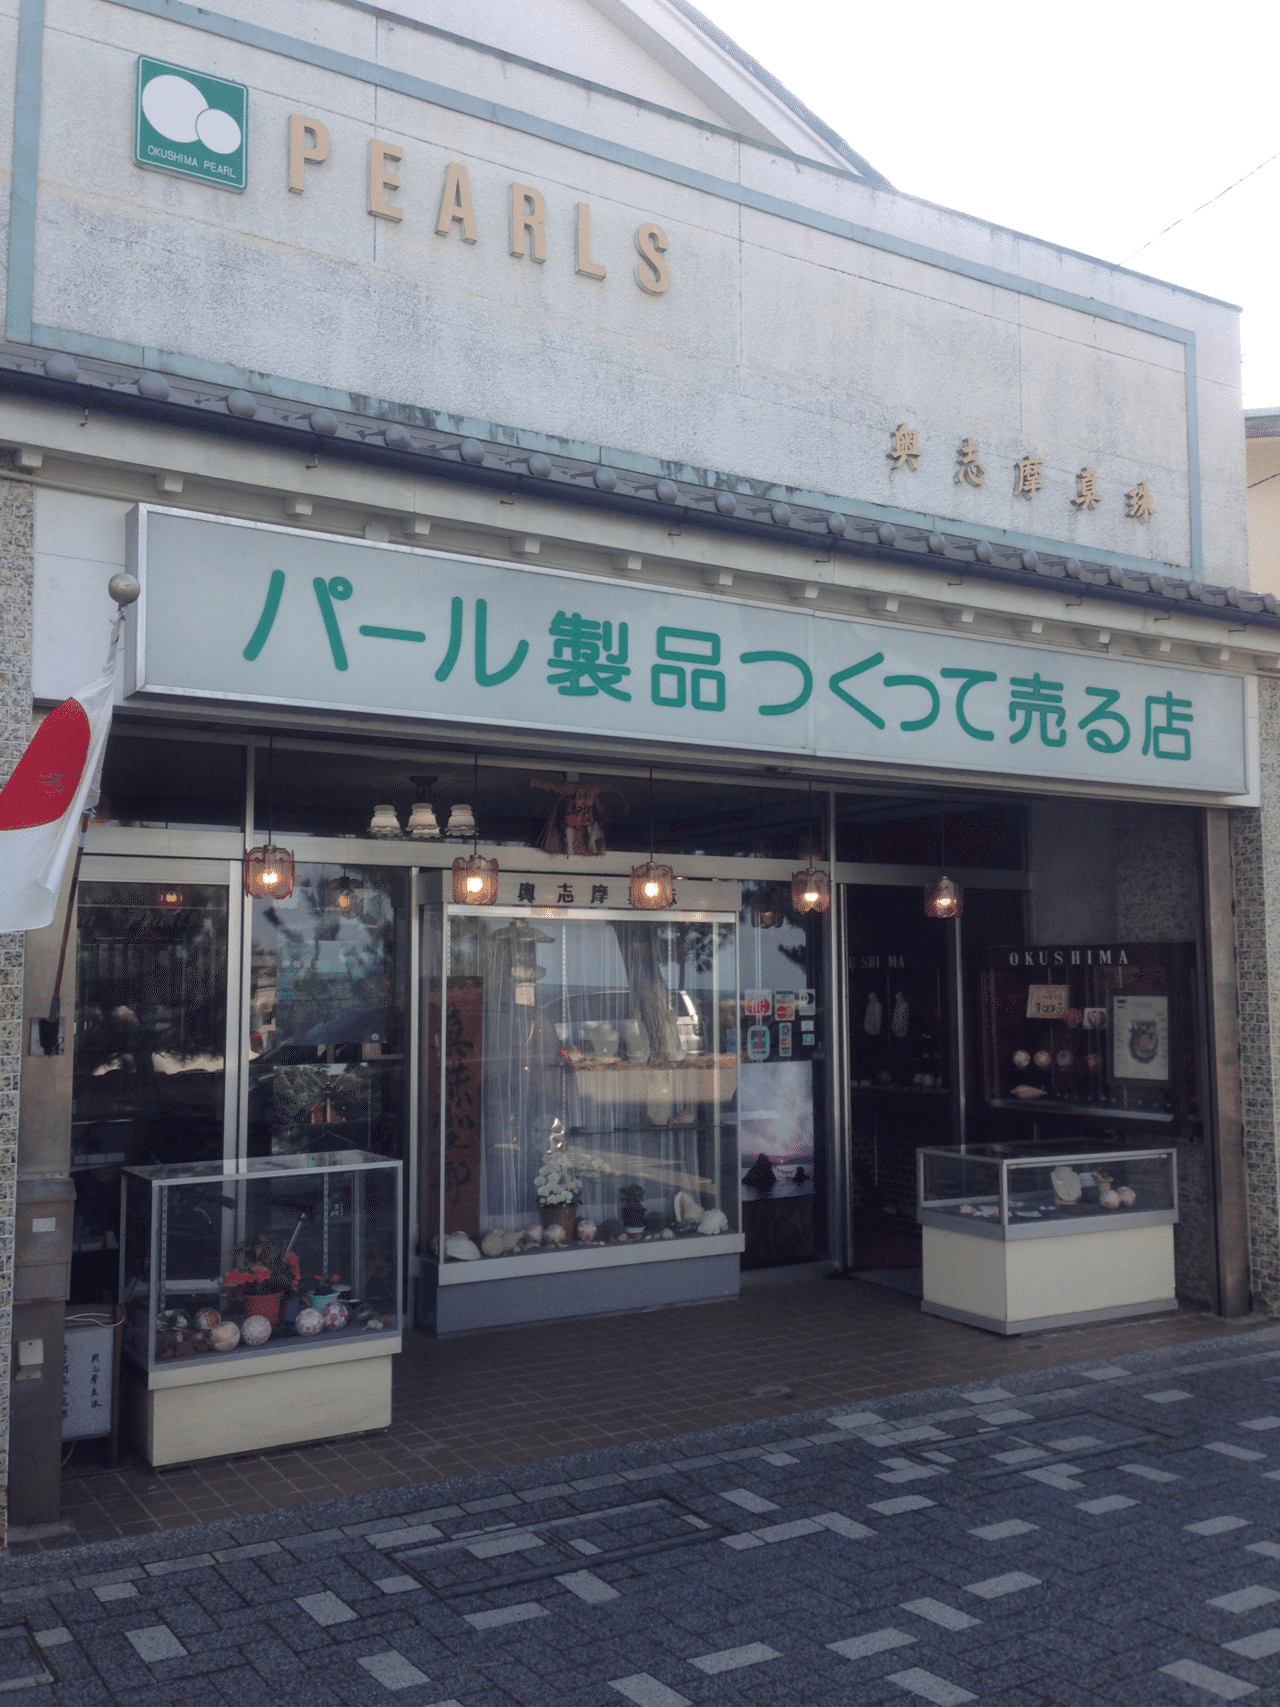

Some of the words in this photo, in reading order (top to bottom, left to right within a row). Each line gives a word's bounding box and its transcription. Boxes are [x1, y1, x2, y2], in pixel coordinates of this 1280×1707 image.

[147, 145, 198, 167] OKUSHIMA
[203, 160, 236, 178] PEARL
[288, 113, 671, 295] PEARLS
[242, 569, 1194, 761] パール製品つくって売る店
[1009, 950, 1129, 966] OKUSHIMA
